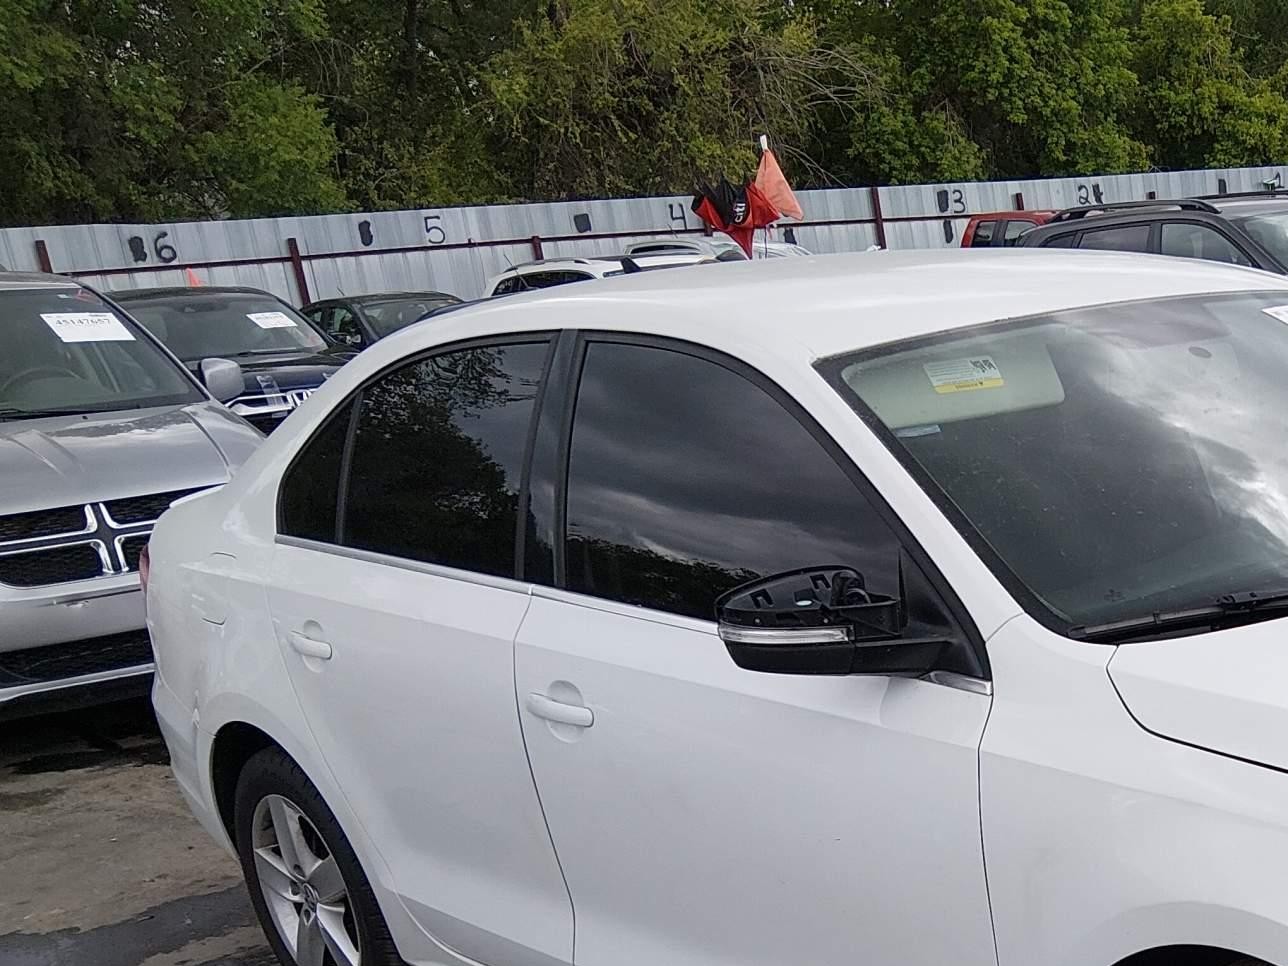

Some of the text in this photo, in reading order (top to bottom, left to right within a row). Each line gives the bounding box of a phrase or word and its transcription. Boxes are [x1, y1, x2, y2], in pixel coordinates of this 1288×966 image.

[734, 202, 746, 223] citi
[952, 189, 966, 213] 3
[424, 215, 448, 246] 5
[669, 202, 688, 231] 4
[154, 232, 178, 264] 6
